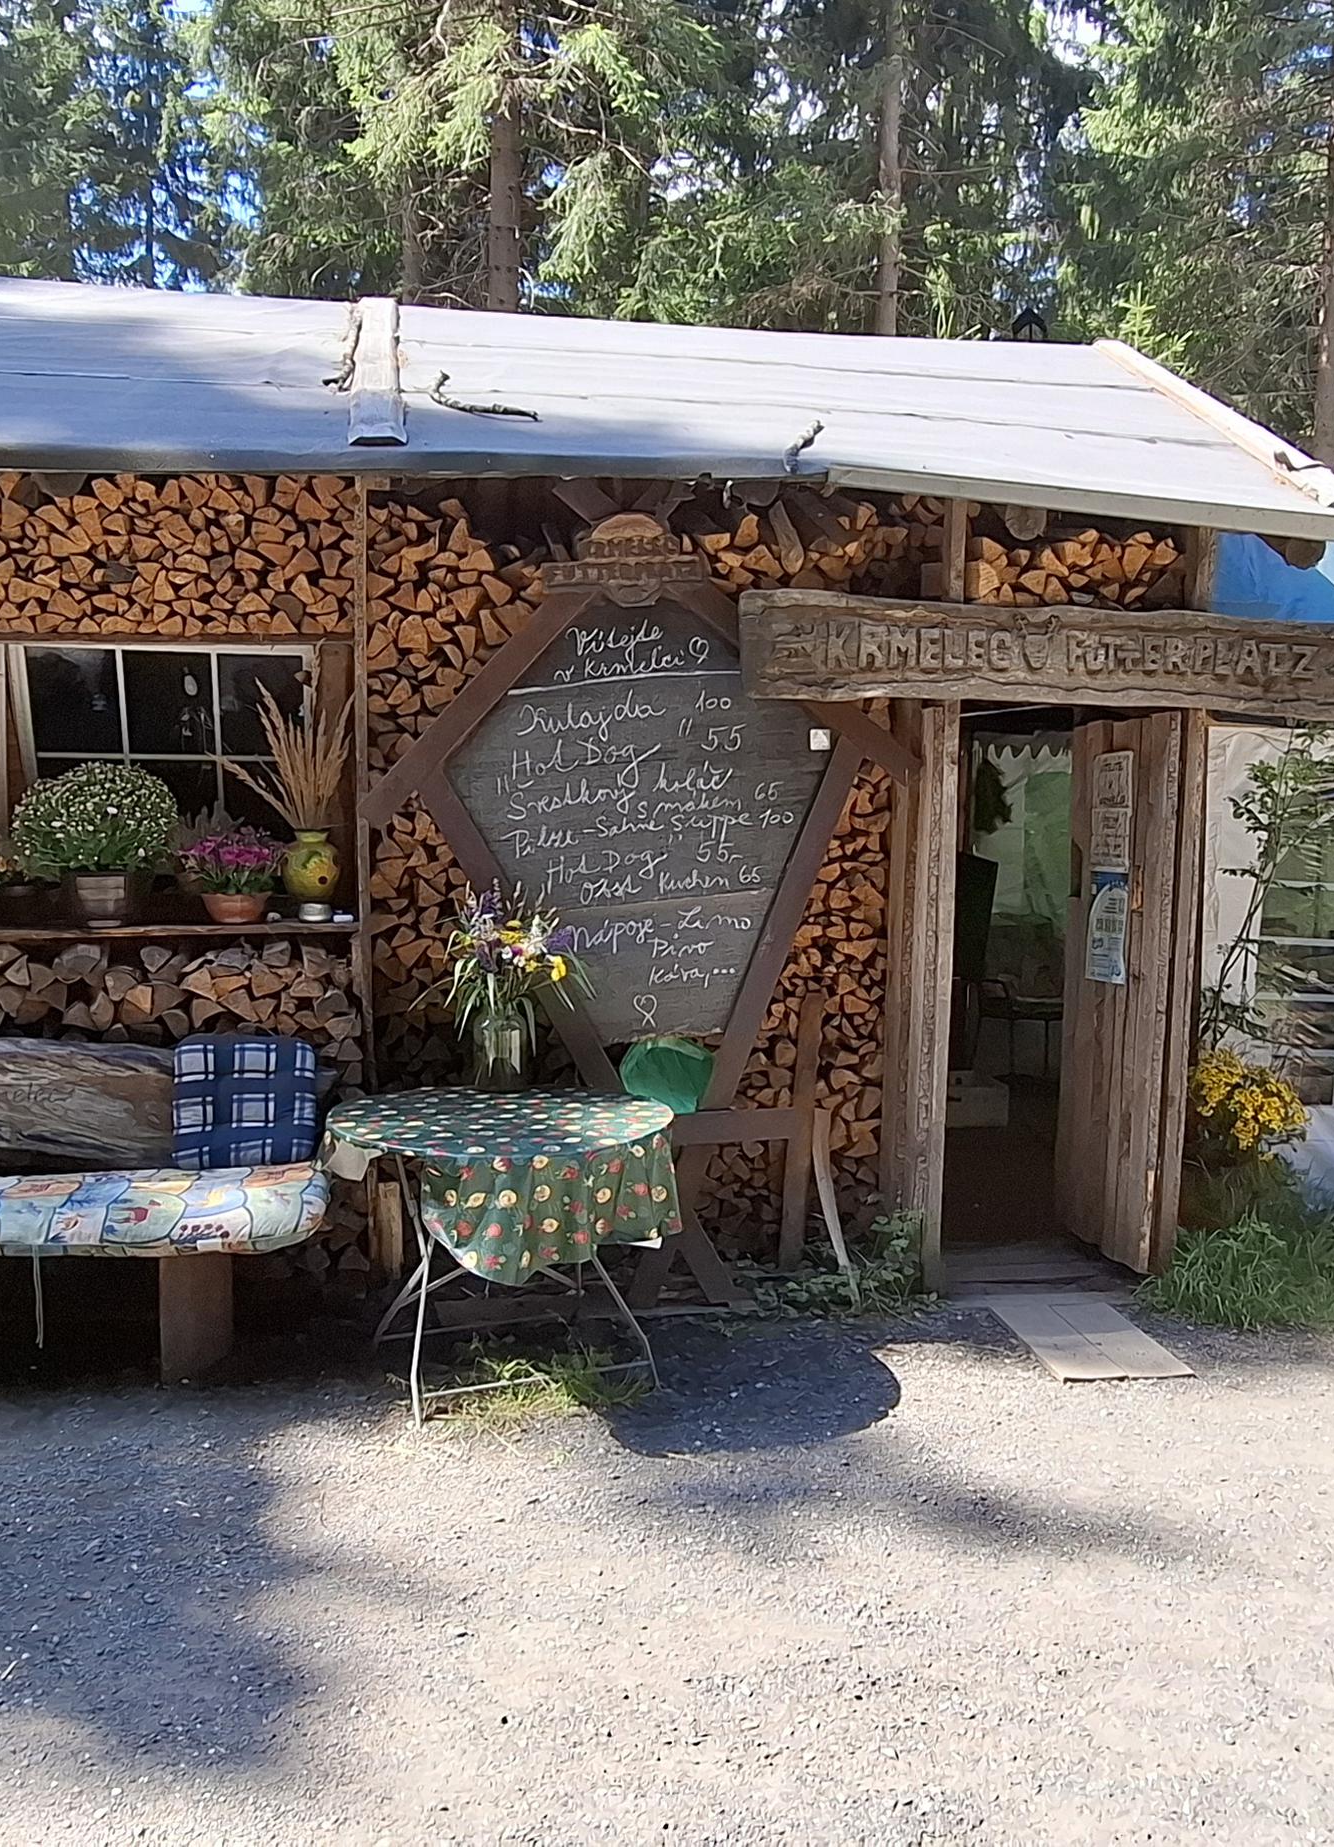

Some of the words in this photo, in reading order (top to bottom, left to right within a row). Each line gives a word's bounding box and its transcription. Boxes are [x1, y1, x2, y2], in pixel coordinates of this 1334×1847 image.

[565, 618, 664, 664] Vítejte
[825, 620, 1013, 672] KRMELEC
[1065, 630, 1320, 680] FUTTERPLATZ
[516, 689, 667, 742] Kulajda
[695, 689, 732, 713] 100
[700, 722, 748, 752] 55
[754, 780, 785, 801] 65
[758, 808, 795, 829] 100
[738, 863, 766, 884] 65
[677, 905, 752, 931] Limo
[645, 932, 715, 959] Pivo
